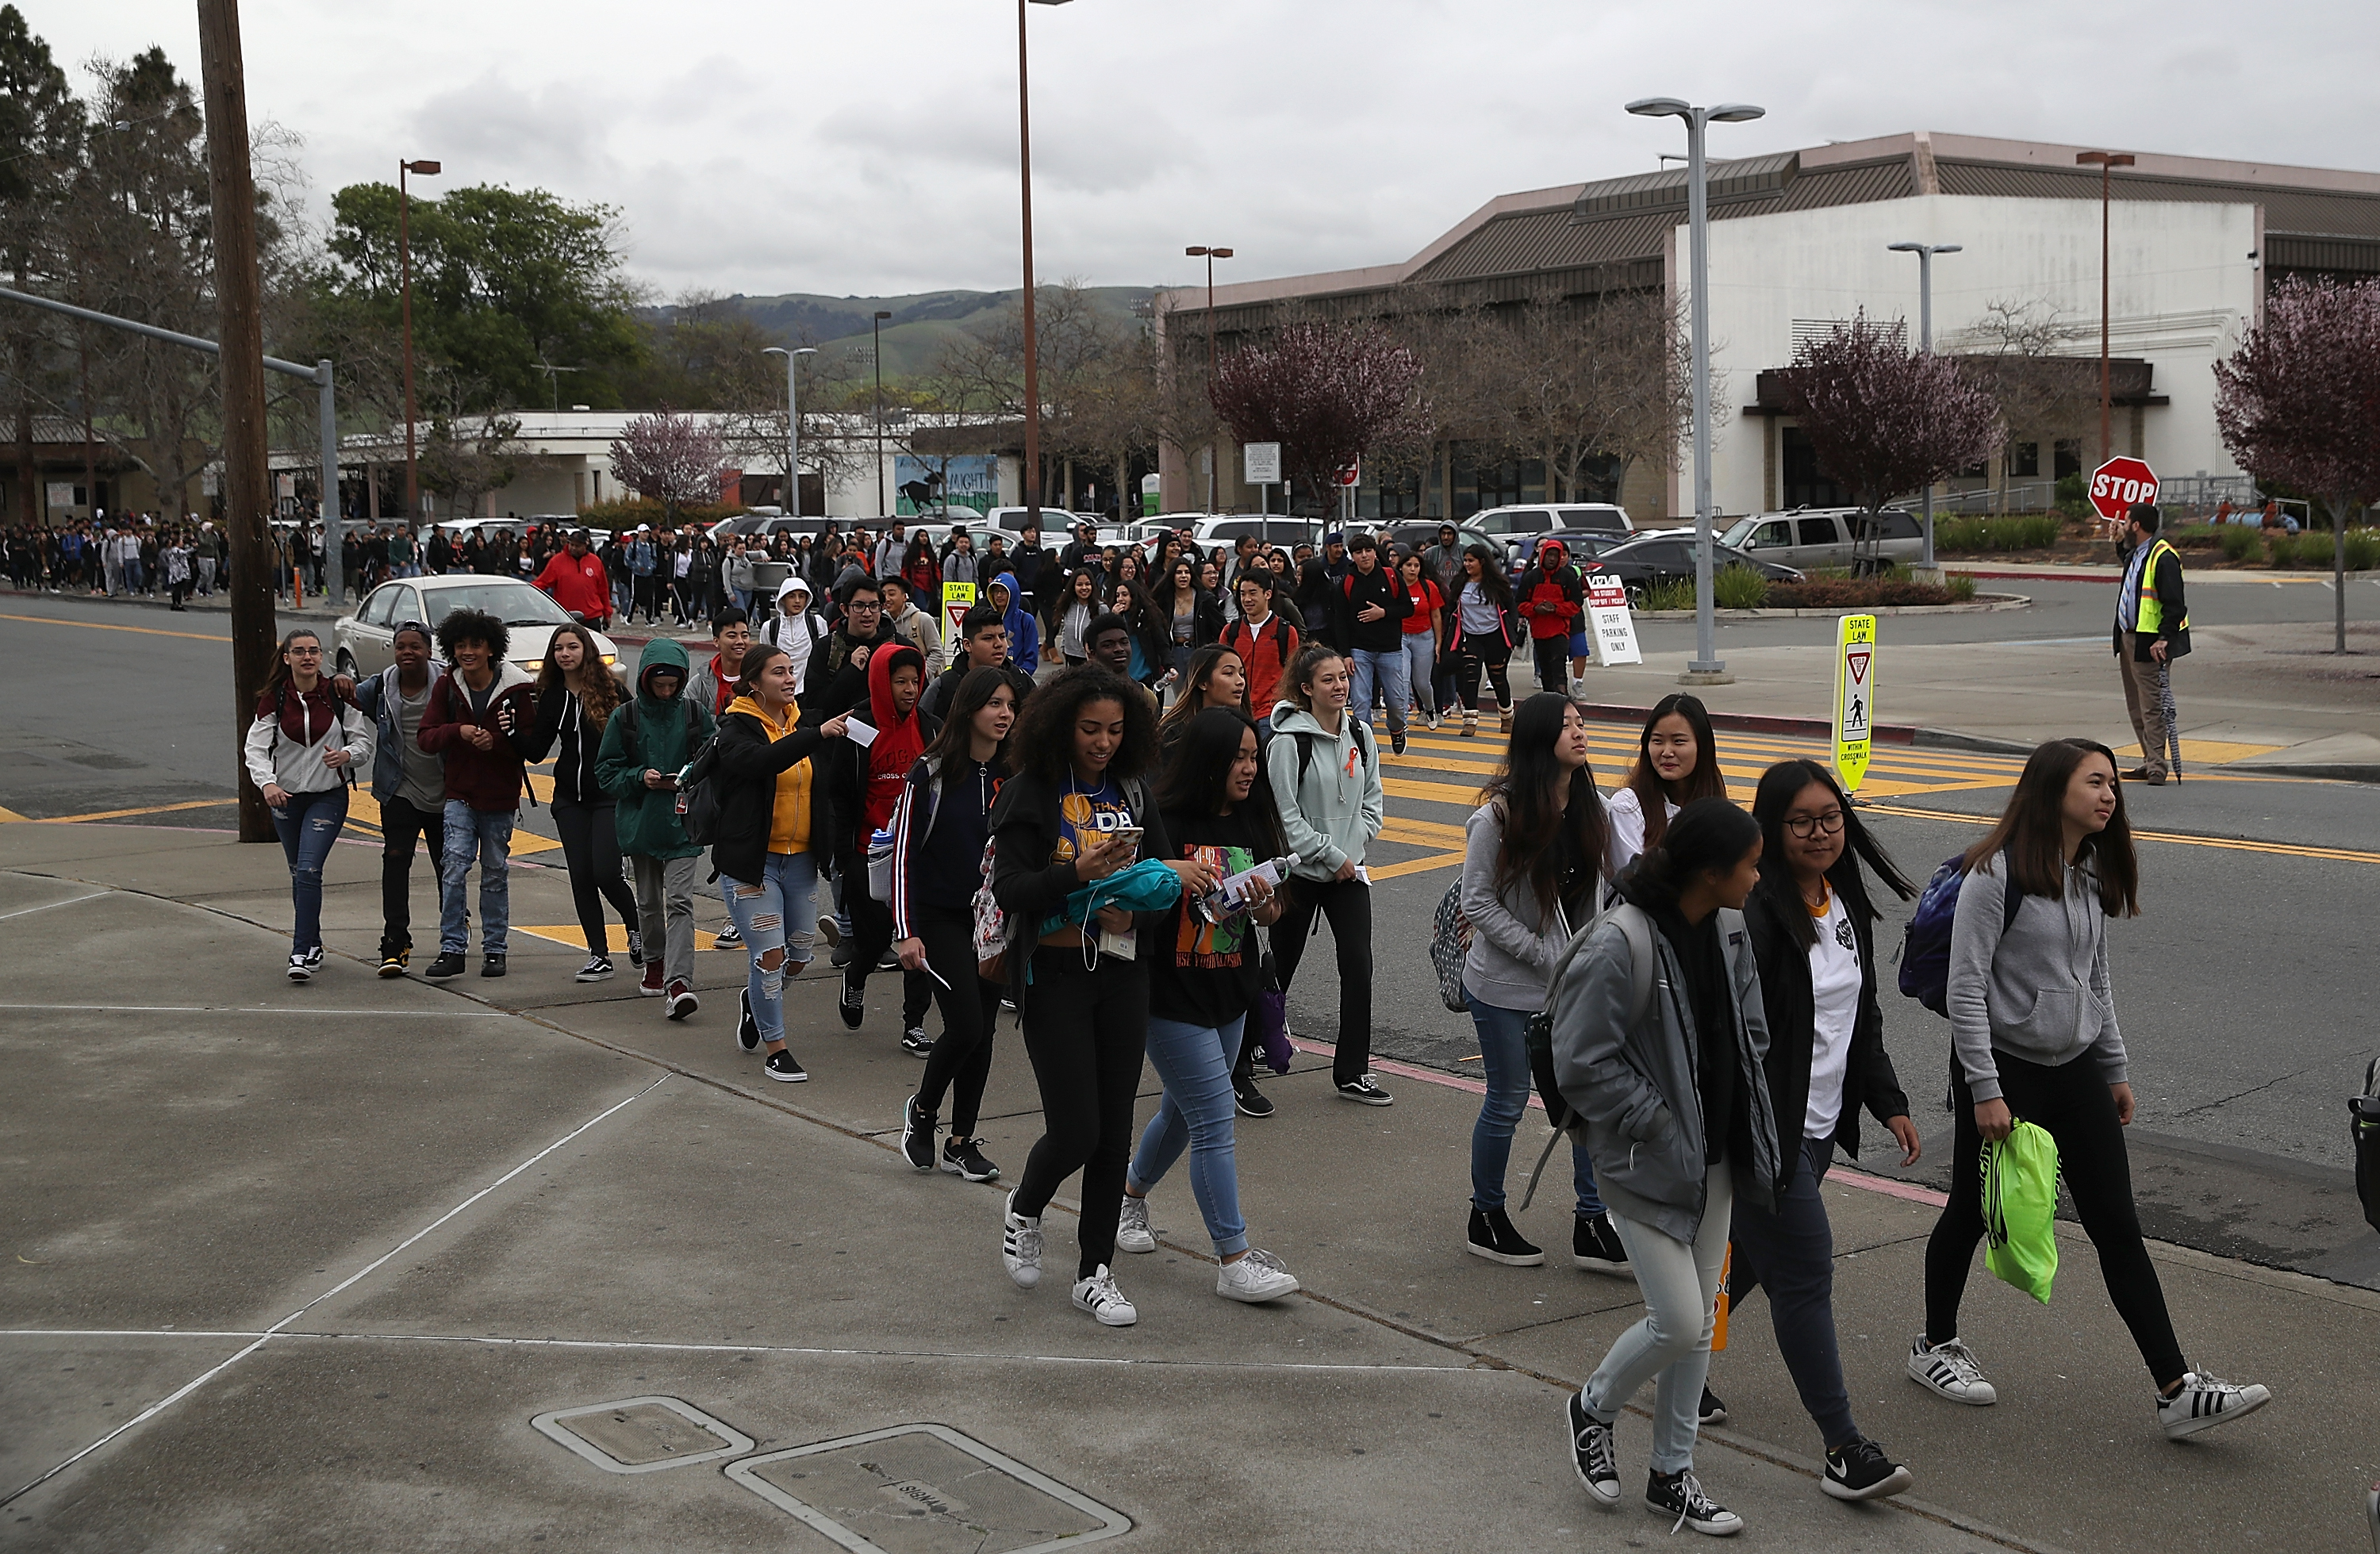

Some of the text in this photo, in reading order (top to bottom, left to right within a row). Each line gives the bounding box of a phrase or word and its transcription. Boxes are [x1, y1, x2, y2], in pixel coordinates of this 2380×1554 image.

[950, 473, 988, 490] MIGHT
[2094, 474, 2155, 503] STOP
[1602, 614, 1619, 624] STAFF
[1849, 620, 1870, 629] STATE
[1602, 627, 1628, 639] PARKING
[1852, 631, 1867, 640] LAW
[1610, 642, 1626, 651] ONLY
[876, 749, 918, 772] LOGA
[1841, 752, 1868, 761] CROSSWALK
[1096, 811, 1134, 831] DA
[1177, 952, 1191, 967] USE
[1195, 954, 1216, 969] YOUR
